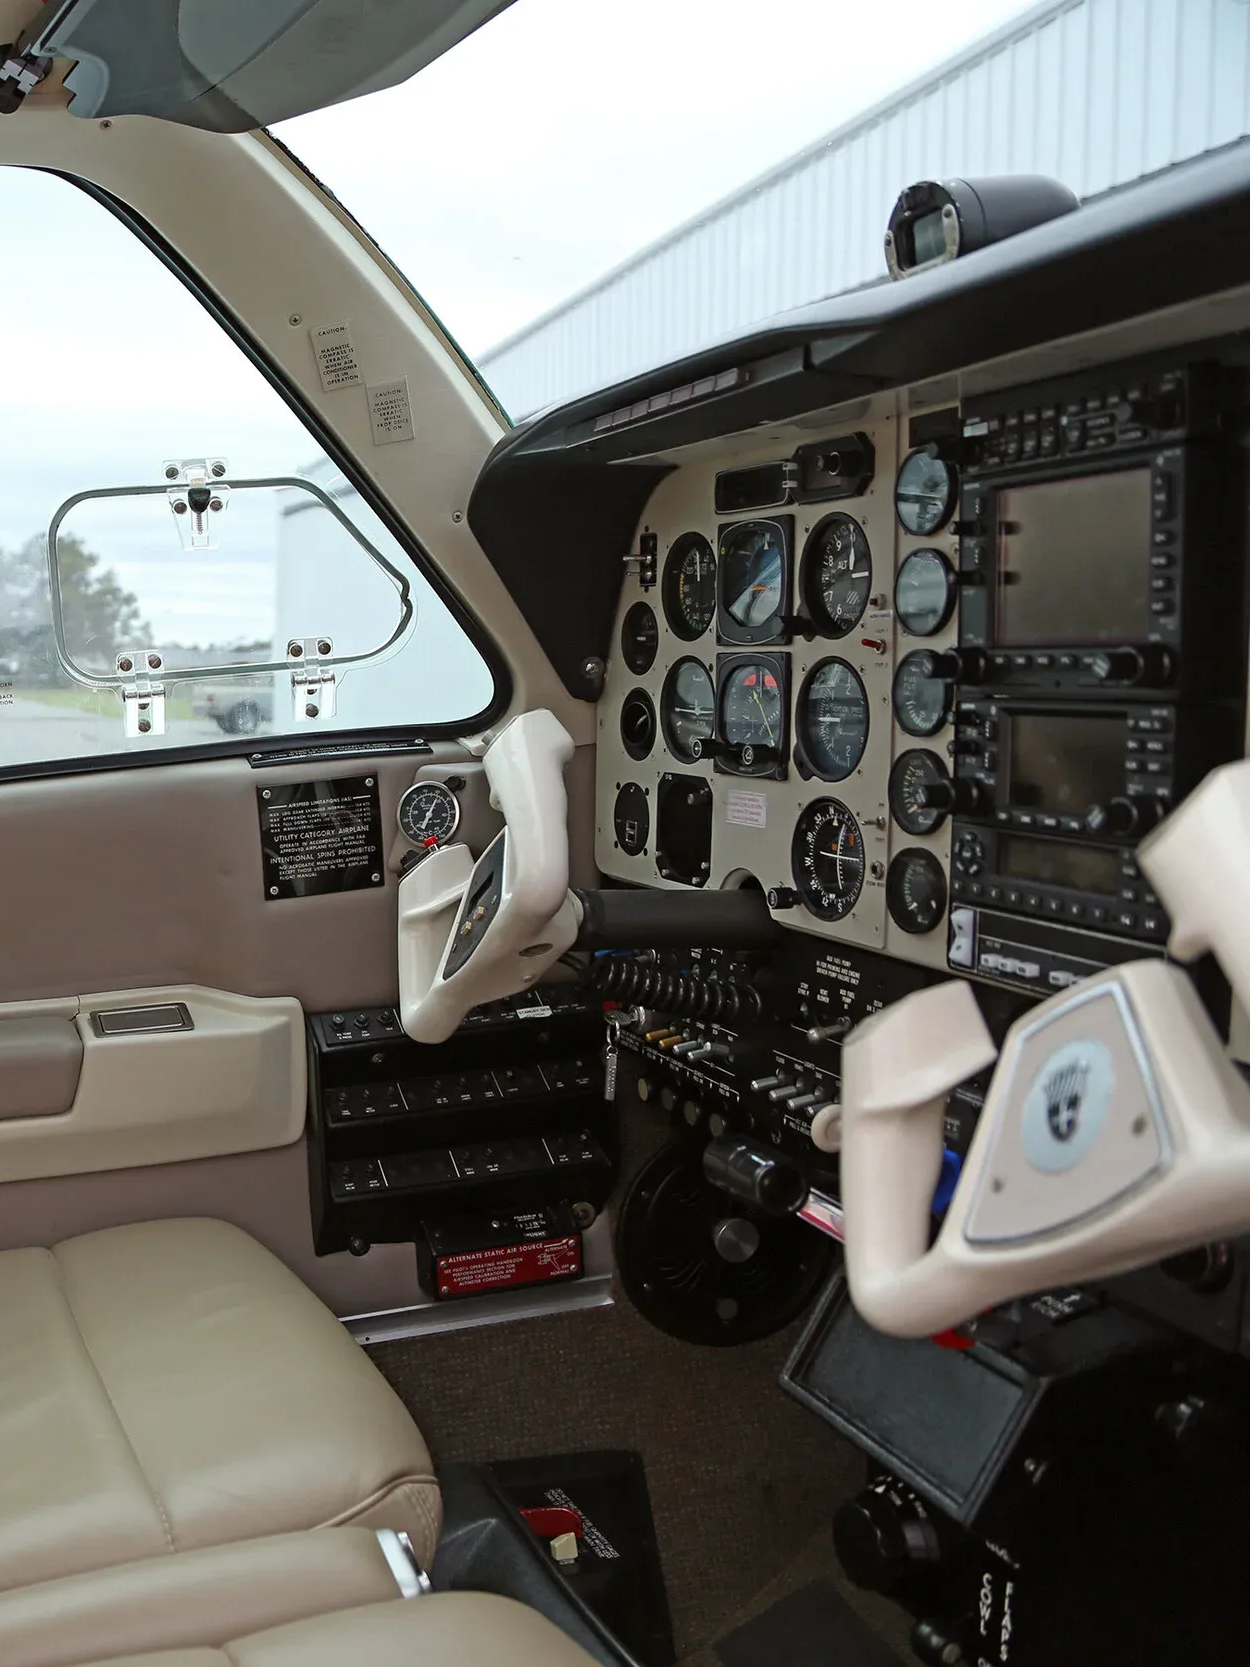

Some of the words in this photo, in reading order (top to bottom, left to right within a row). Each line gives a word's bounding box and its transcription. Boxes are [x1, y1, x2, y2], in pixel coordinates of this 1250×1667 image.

[321, 343, 350, 353] MAGNETIC
[319, 349, 347, 359] COMPASS
[326, 355, 350, 363] ERRATIC
[323, 364, 357, 375] CONDITIONER
[327, 375, 358, 385] OPERATION
[375, 390, 401, 398] CAUTION
[375, 398, 404, 406] MAGNETIC
[373, 404, 400, 413] COMPASS
[380, 409, 402, 417] ERRATIC
[838, 560, 848, 570] ALT
[274, 833, 299, 842] UTILITY
[300, 829, 335, 839] CATEGORY
[338, 825, 369, 834] AIRPLANE
[270, 854, 314, 864] INTENTIONAL
[338, 846, 376, 855] PROHIBITED
[805, 856, 811, 866] W
[838, 902, 842, 912] S
[448, 1253, 483, 1263] ALTERNATE
[520, 1243, 542, 1252] SOURCE
[979, 1572, 993, 1636] COWL
[999, 1581, 1014, 1662] FLAPS
